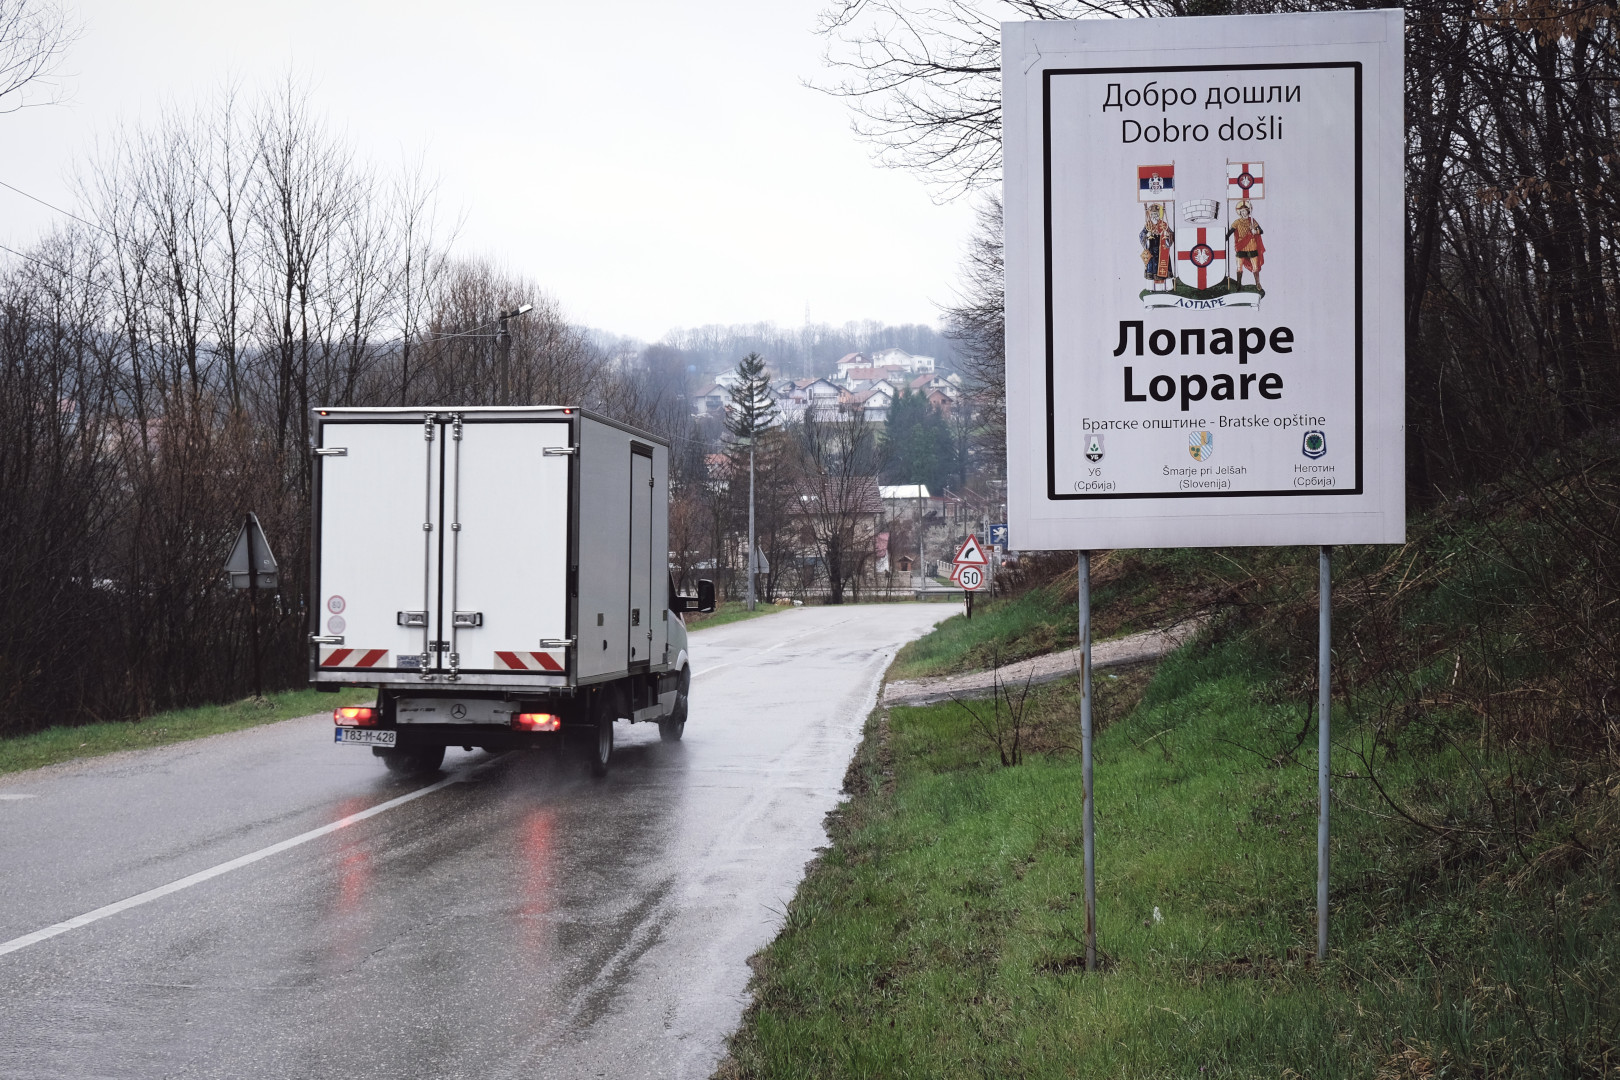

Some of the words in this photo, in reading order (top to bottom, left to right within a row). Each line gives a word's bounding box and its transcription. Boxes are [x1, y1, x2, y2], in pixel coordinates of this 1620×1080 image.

[1103, 81, 1196, 112] Добро
[1205, 84, 1301, 110] дошли
[1123, 118, 1209, 143] Dobro
[1218, 115, 1282, 141] došli
[1113, 320, 1294, 364] Лопаре
[1124, 367, 1283, 411] Lopare
[1083, 418, 1138, 433] Братске
[1143, 419, 1206, 429] општине
[1220, 415, 1269, 427] Bratske
[1274, 414, 1325, 429] opštine
[1088, 467, 1102, 477] Уб
[1163, 465, 1197, 477] Šmarje
[1200, 467, 1213, 477] pri
[1215, 465, 1247, 475] Jelšah
[1294, 464, 1335, 473] Неготин
[1074, 481, 1115, 491] (Србија)
[1180, 479, 1230, 490] (Slovenija)
[1294, 477, 1335, 487] (Србија)
[963, 572, 979, 585] 50
[344, 730, 395, 743] T83-M-428
